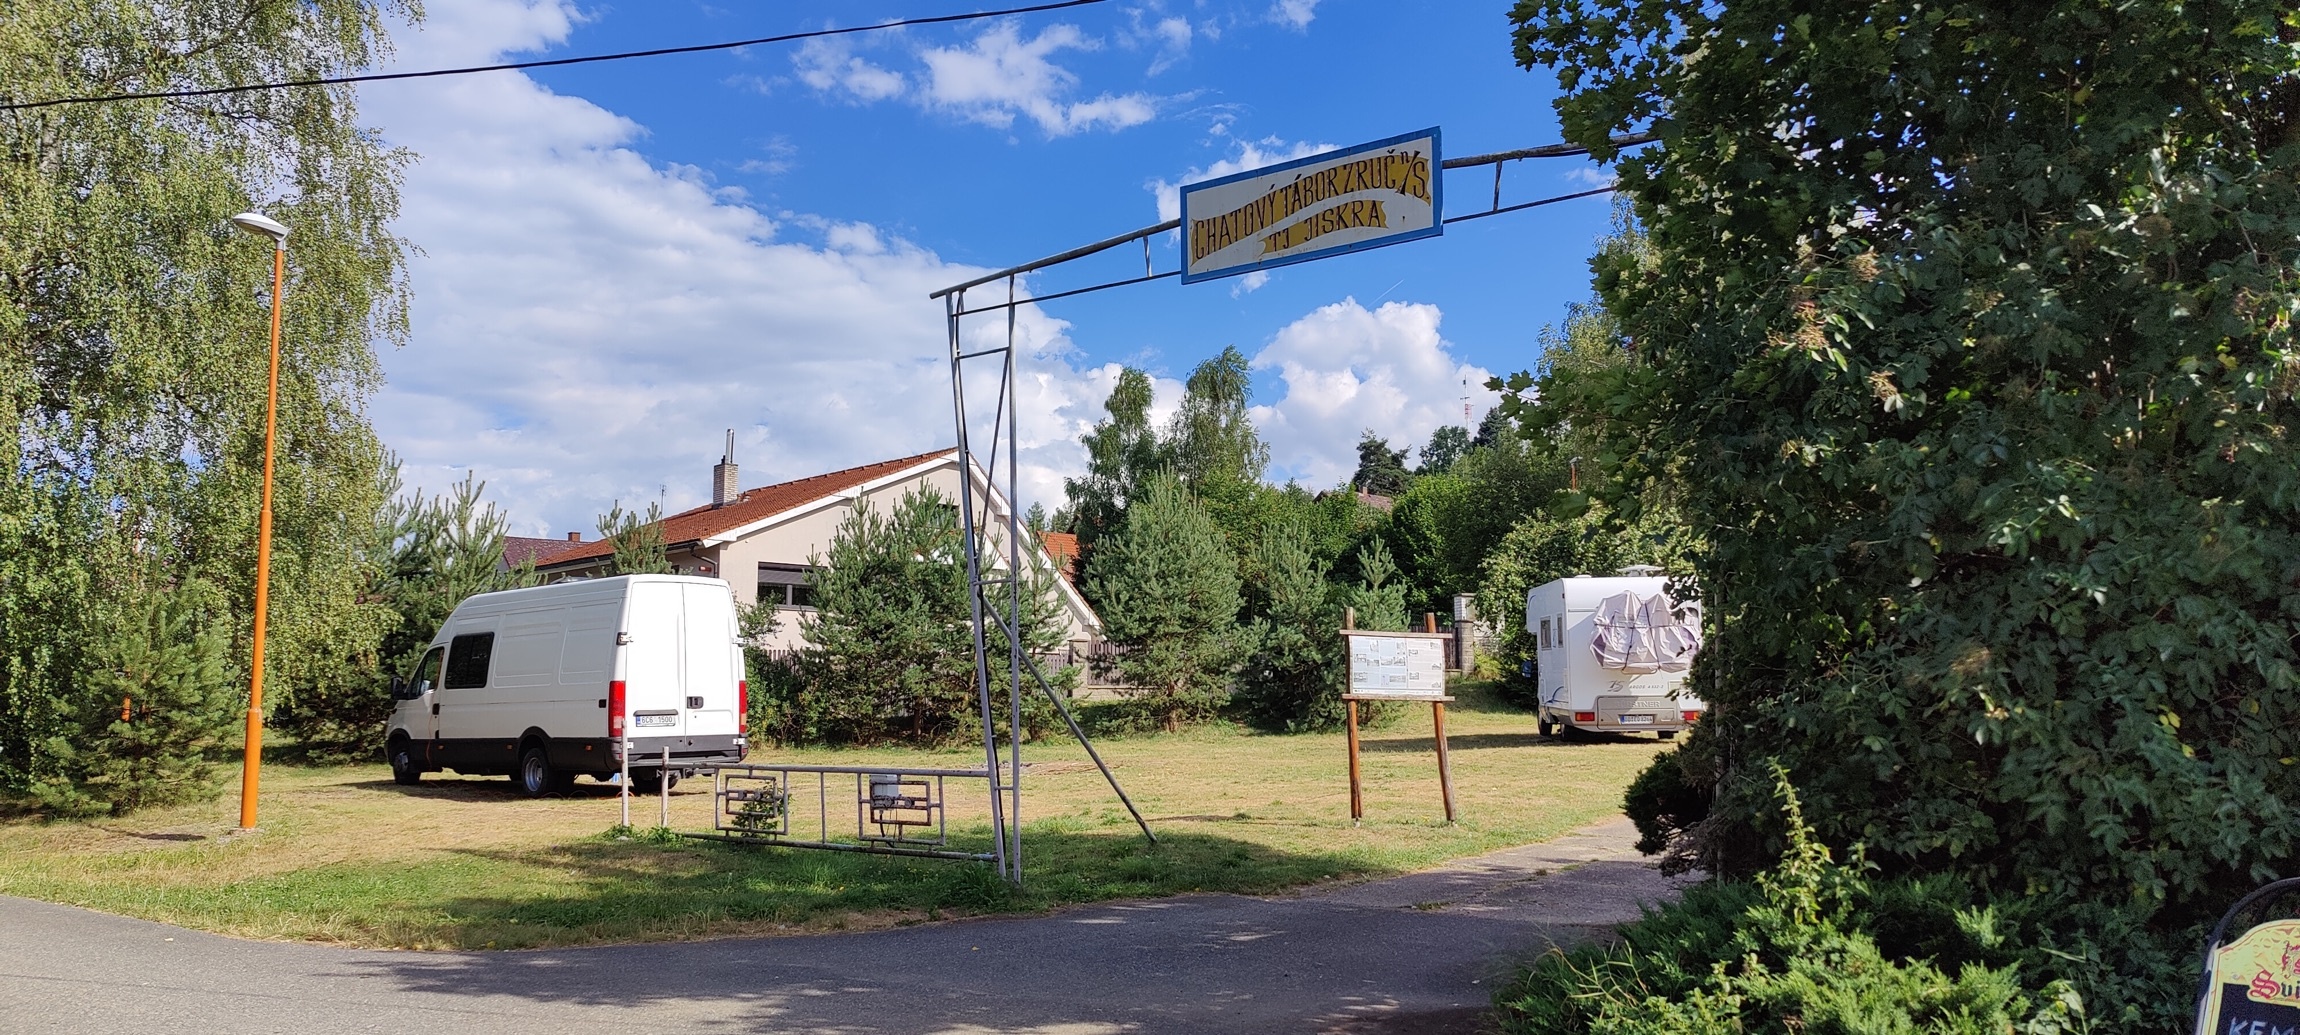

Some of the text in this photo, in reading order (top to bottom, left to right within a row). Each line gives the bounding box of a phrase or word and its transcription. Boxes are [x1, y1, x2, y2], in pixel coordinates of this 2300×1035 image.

[1195, 183, 1276, 260] CHATOVÝ
[1280, 173, 1340, 218] TÁBOR
[1343, 148, 1396, 195] ZRUČ
[1269, 200, 1381, 252] TJ JISKRA
[641, 715, 673, 724] 6C6 1500
